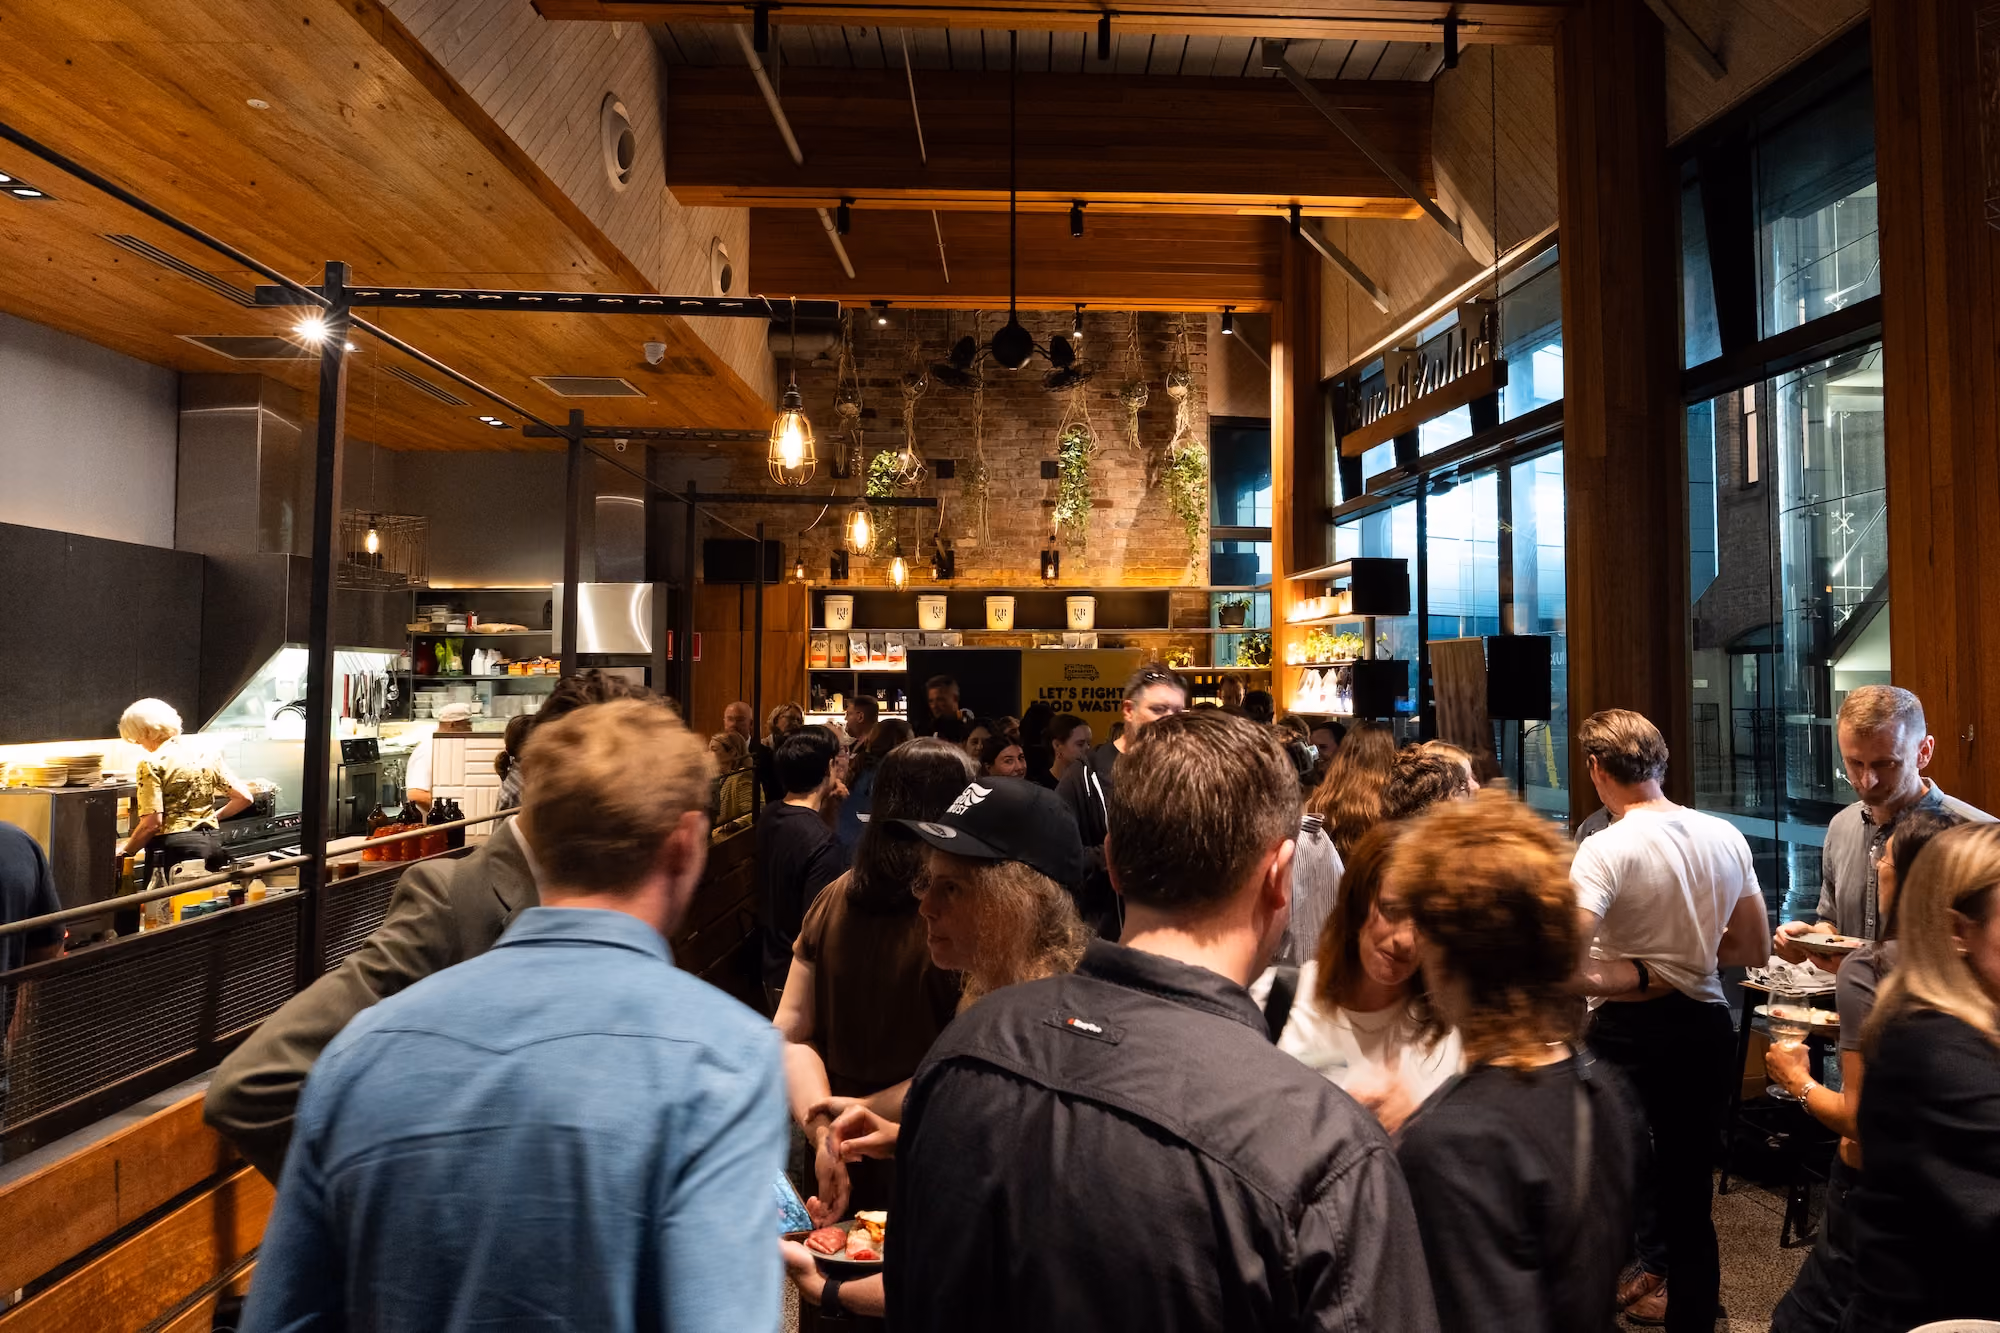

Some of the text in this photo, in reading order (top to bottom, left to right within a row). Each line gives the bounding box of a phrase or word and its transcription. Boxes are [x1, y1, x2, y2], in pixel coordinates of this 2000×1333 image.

[1039, 687, 1125, 699] LET'S FIGHT
[1078, 700, 1121, 712] WAST
